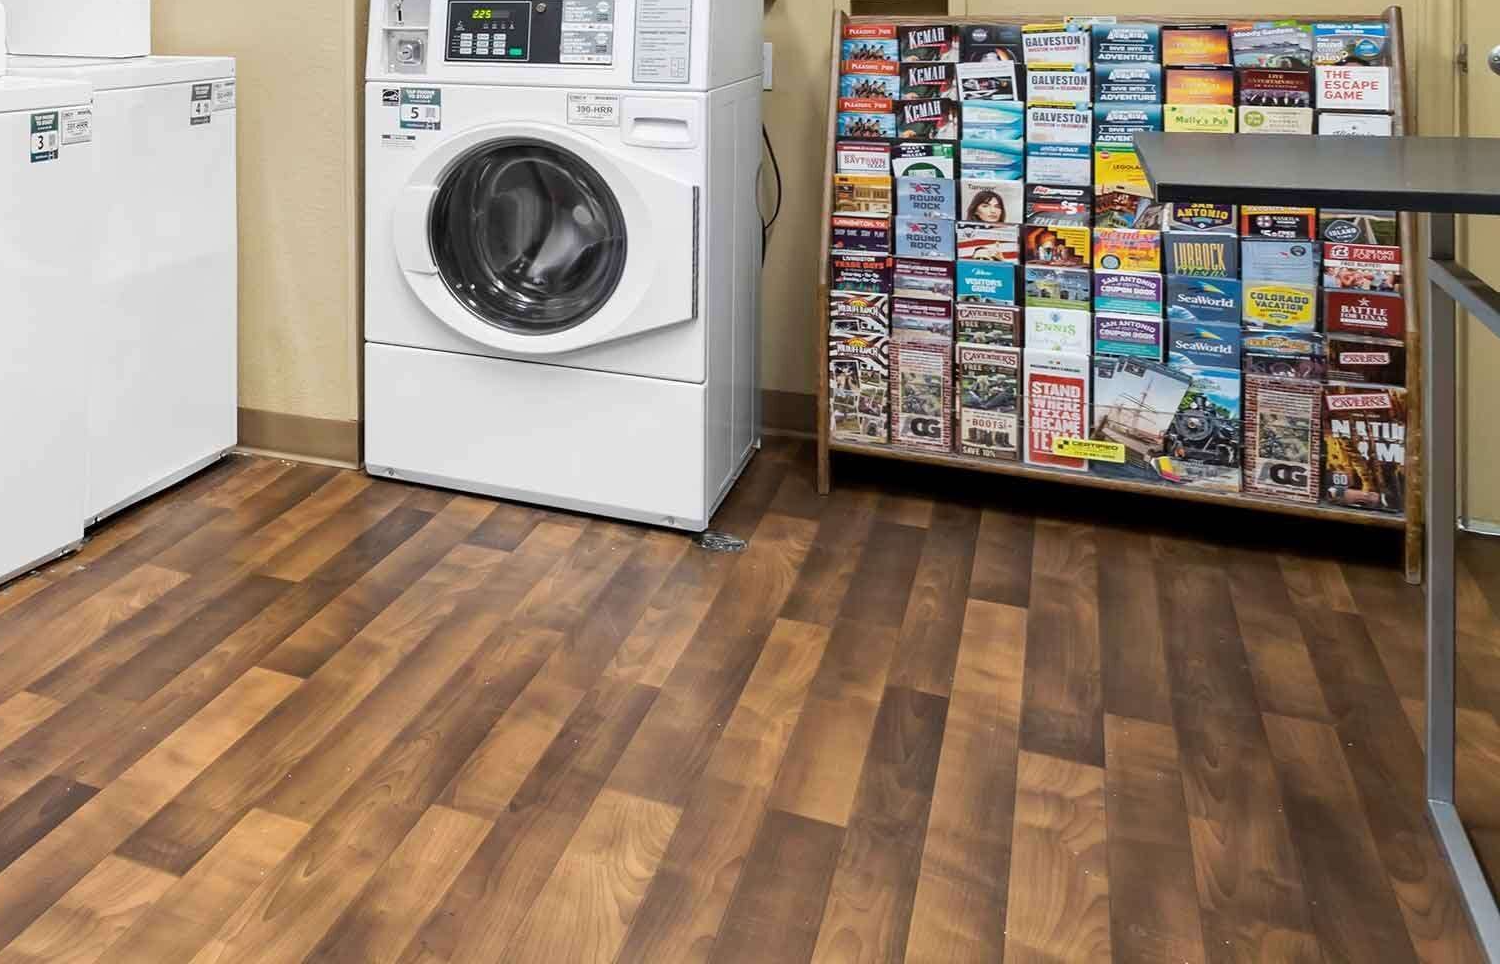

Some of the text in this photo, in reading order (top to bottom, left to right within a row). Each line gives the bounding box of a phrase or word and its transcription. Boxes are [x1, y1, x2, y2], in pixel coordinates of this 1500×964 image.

[908, 27, 945, 50] KEMAH
[1025, 35, 1080, 47] GALVESTON
[1097, 53, 1154, 61] ADVENTURE
[908, 64, 946, 87] KEMAH
[1031, 75, 1088, 86] GALVESTON
[1324, 70, 1351, 80] THE
[1324, 80, 1379, 91] ESCAPE
[1324, 91, 1364, 101] GAME
[410, 106, 419, 119] 5
[904, 100, 941, 125] KEMAH
[1032, 111, 1089, 124] GALVESTON
[1175, 116, 1229, 125] Molly's Pub
[37, 135, 45, 150] 3
[1097, 134, 1133, 142] ADVEN
[909, 194, 946, 204] ROUND
[913, 202, 941, 211] ROCK
[1177, 208, 1229, 220] ANTONIO
[906, 234, 942, 243] ROUND
[910, 241, 939, 250] ROCK
[1173, 242, 1226, 271] LUBBOCK
[1101, 276, 1157, 289] SAN ANTONIO
[1177, 294, 1235, 308] SeaWorld
[1250, 291, 1309, 305] COLORADO
[1255, 300, 1303, 311] VACATION
[1340, 305, 1388, 316] BATTLE
[1360, 314, 1388, 322] TEXAS
[1035, 322, 1076, 336] ENNIS
[1119, 320, 1156, 333] ANTONIO
[1175, 340, 1233, 354] SeaWorld
[1031, 381, 1081, 397] STAND
[1031, 398, 1080, 412] WHERE
[1031, 408, 1080, 421] TEXAS
[1331, 420, 1405, 443] NATU
[962, 445, 981, 456] SAVE
[1071, 440, 1118, 451] CERTIFIED
